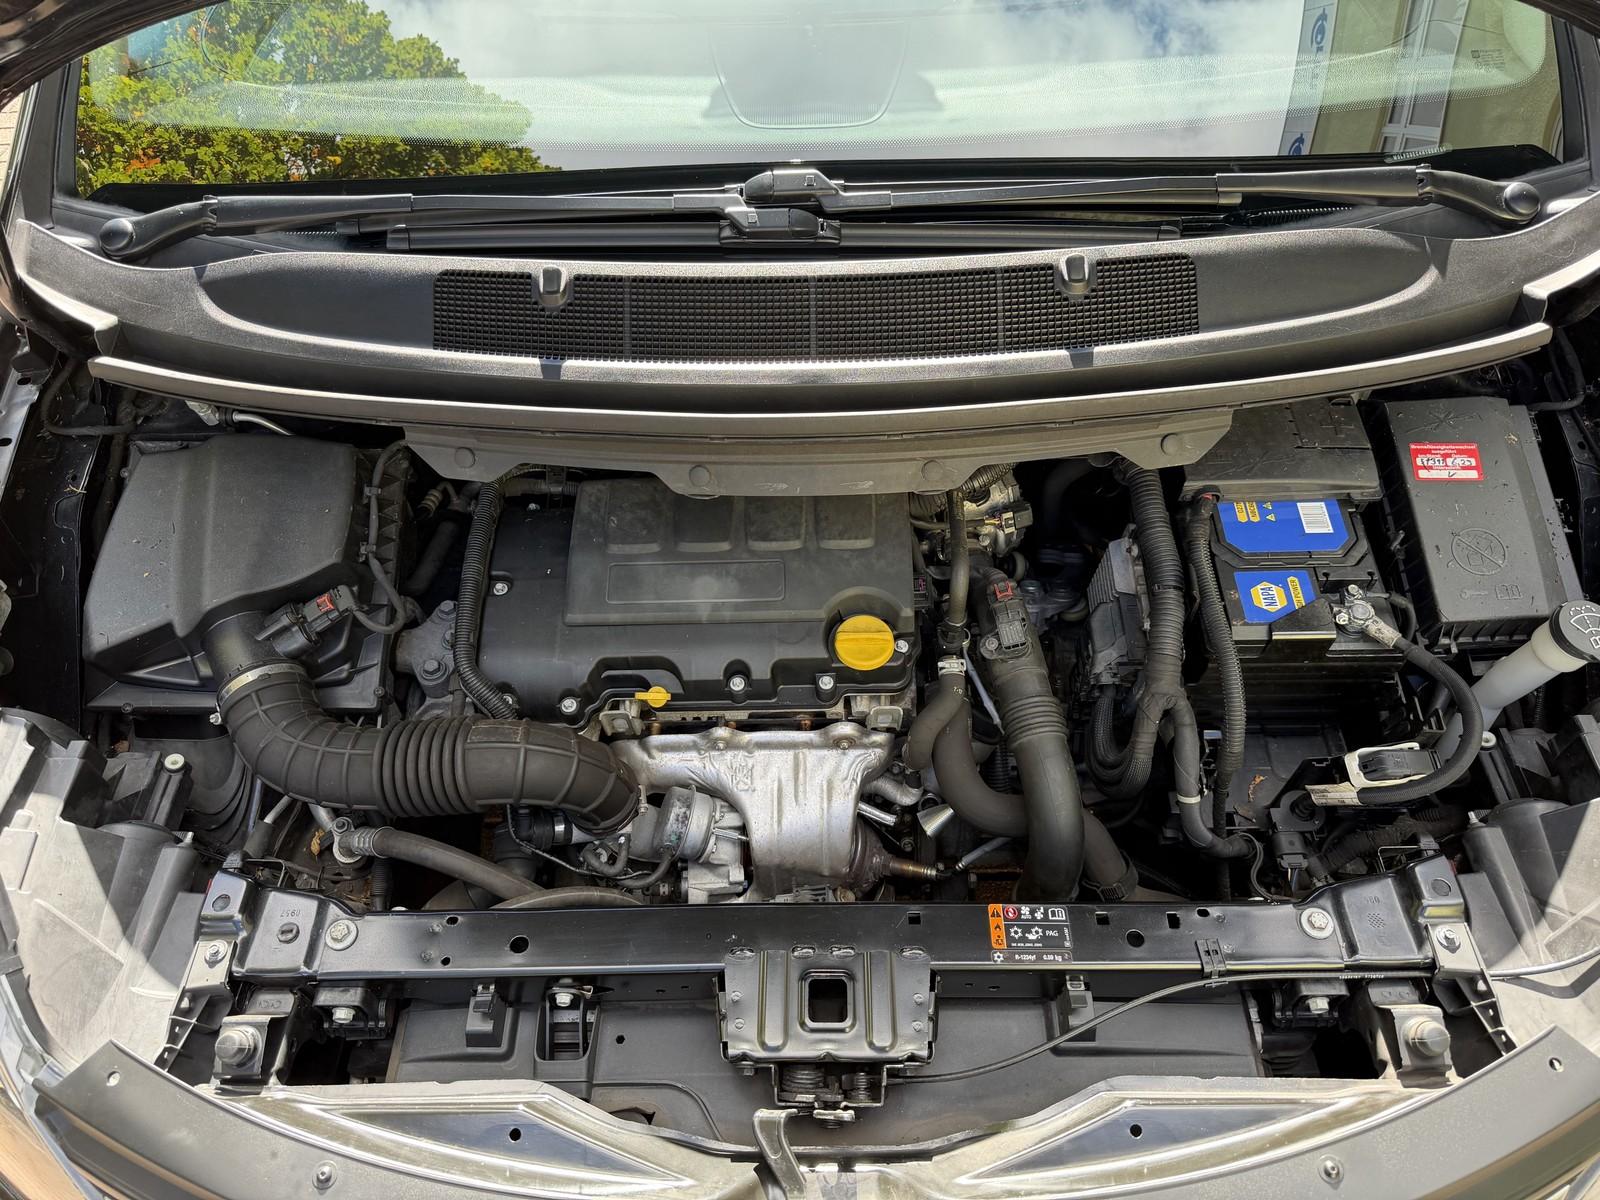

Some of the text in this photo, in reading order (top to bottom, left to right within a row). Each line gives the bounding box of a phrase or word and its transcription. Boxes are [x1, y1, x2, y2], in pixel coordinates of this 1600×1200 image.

[1259, 586, 1279, 607] NAPA
[1289, 579, 1301, 598] POWER
[1055, 954, 1063, 962] kg
